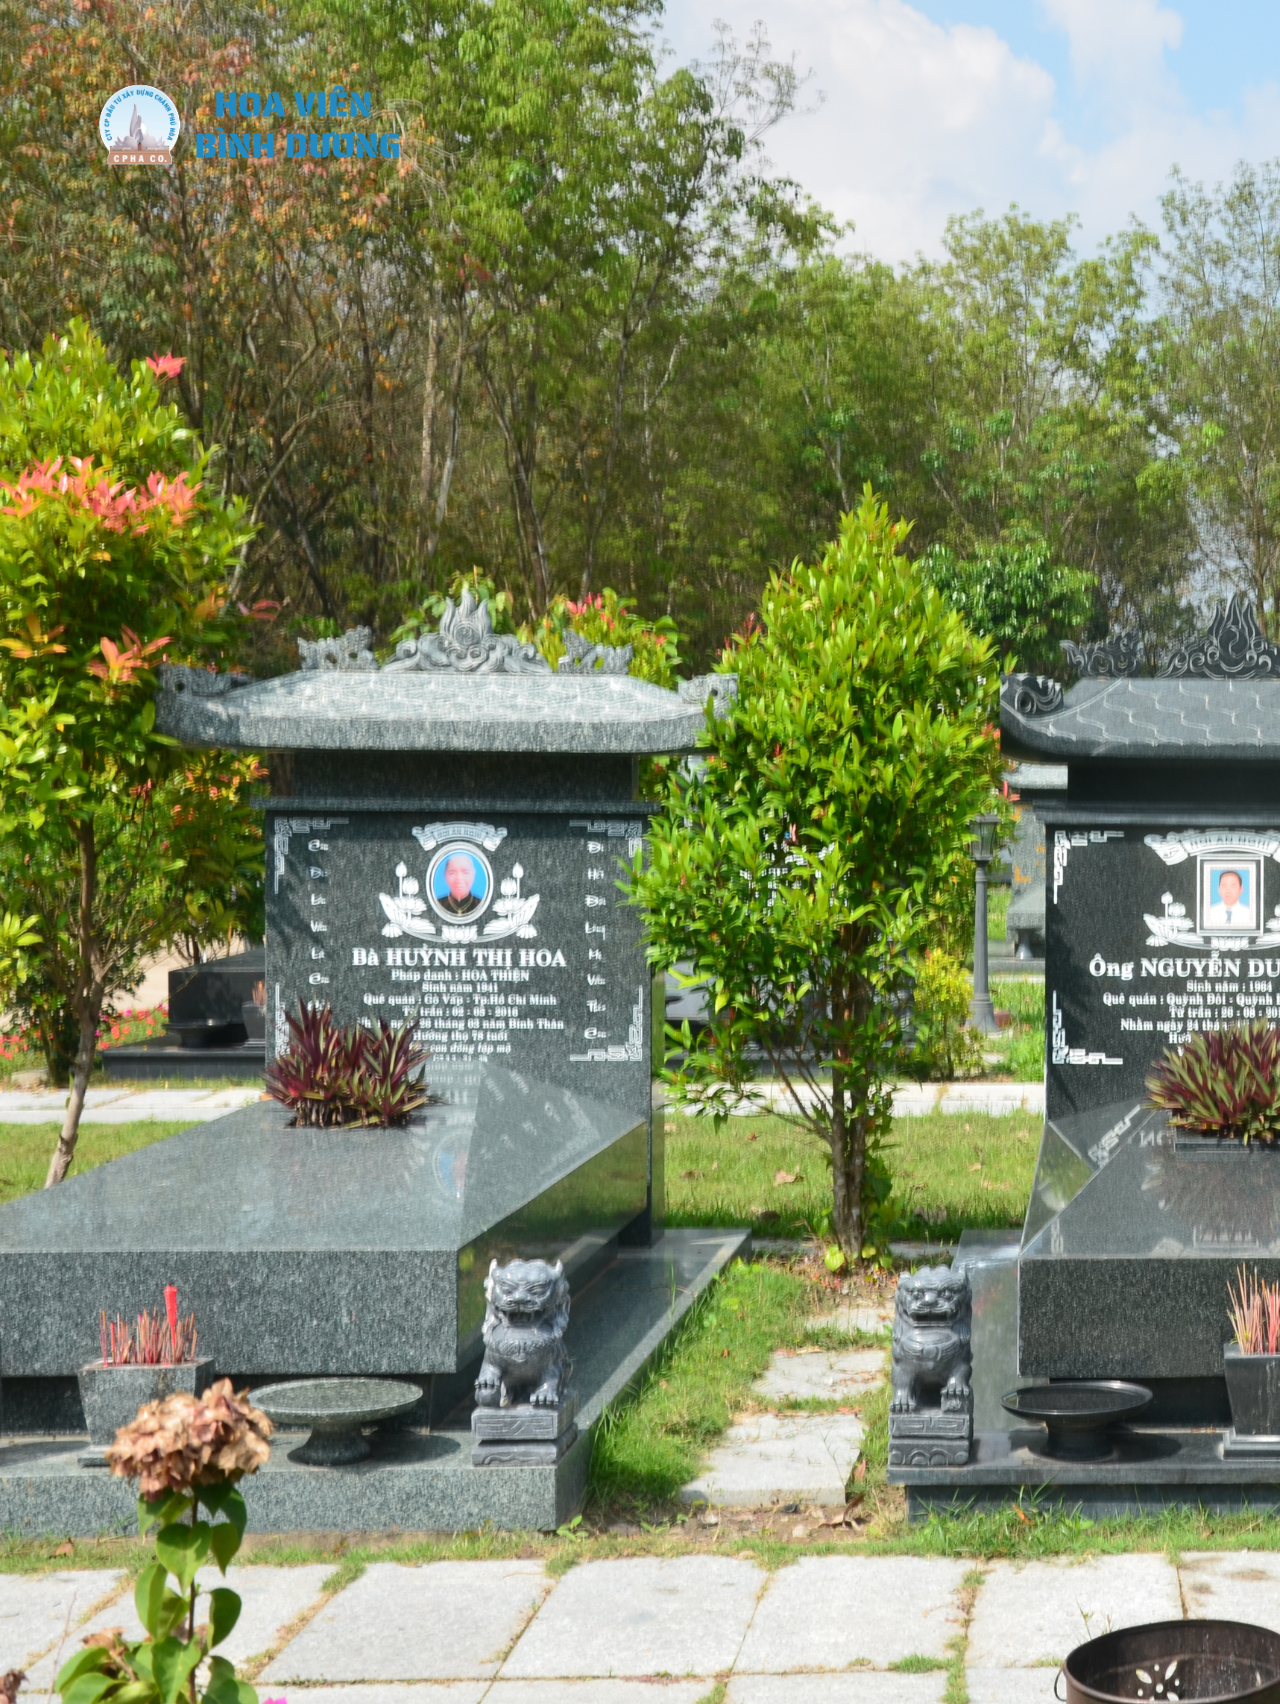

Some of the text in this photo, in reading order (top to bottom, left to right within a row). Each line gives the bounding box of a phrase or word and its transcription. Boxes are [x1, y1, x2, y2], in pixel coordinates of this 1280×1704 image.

[352, 943, 567, 970] Bà HUỲNH THỊ HOA
[1089, 952, 1134, 980] Ông
[1140, 949, 1241, 978] NGUYỄN
[424, 968, 452, 981] danh
[462, 969, 488, 981] HOA
[422, 981, 499, 993] Sinh năm 1941
[1186, 980, 1212, 993] Sinh
[1215, 980, 1239, 993] năm
[1249, 981, 1273, 993] 1964
[363, 992, 386, 1005] Quê
[388, 993, 416, 1006] quán
[529, 993, 557, 1005] Minh
[1103, 992, 1126, 1007] Quê
[1129, 992, 1157, 1007] quán
[1166, 992, 1204, 1007] Quỳnh
[1236, 993, 1273, 1007] Quỳnh
